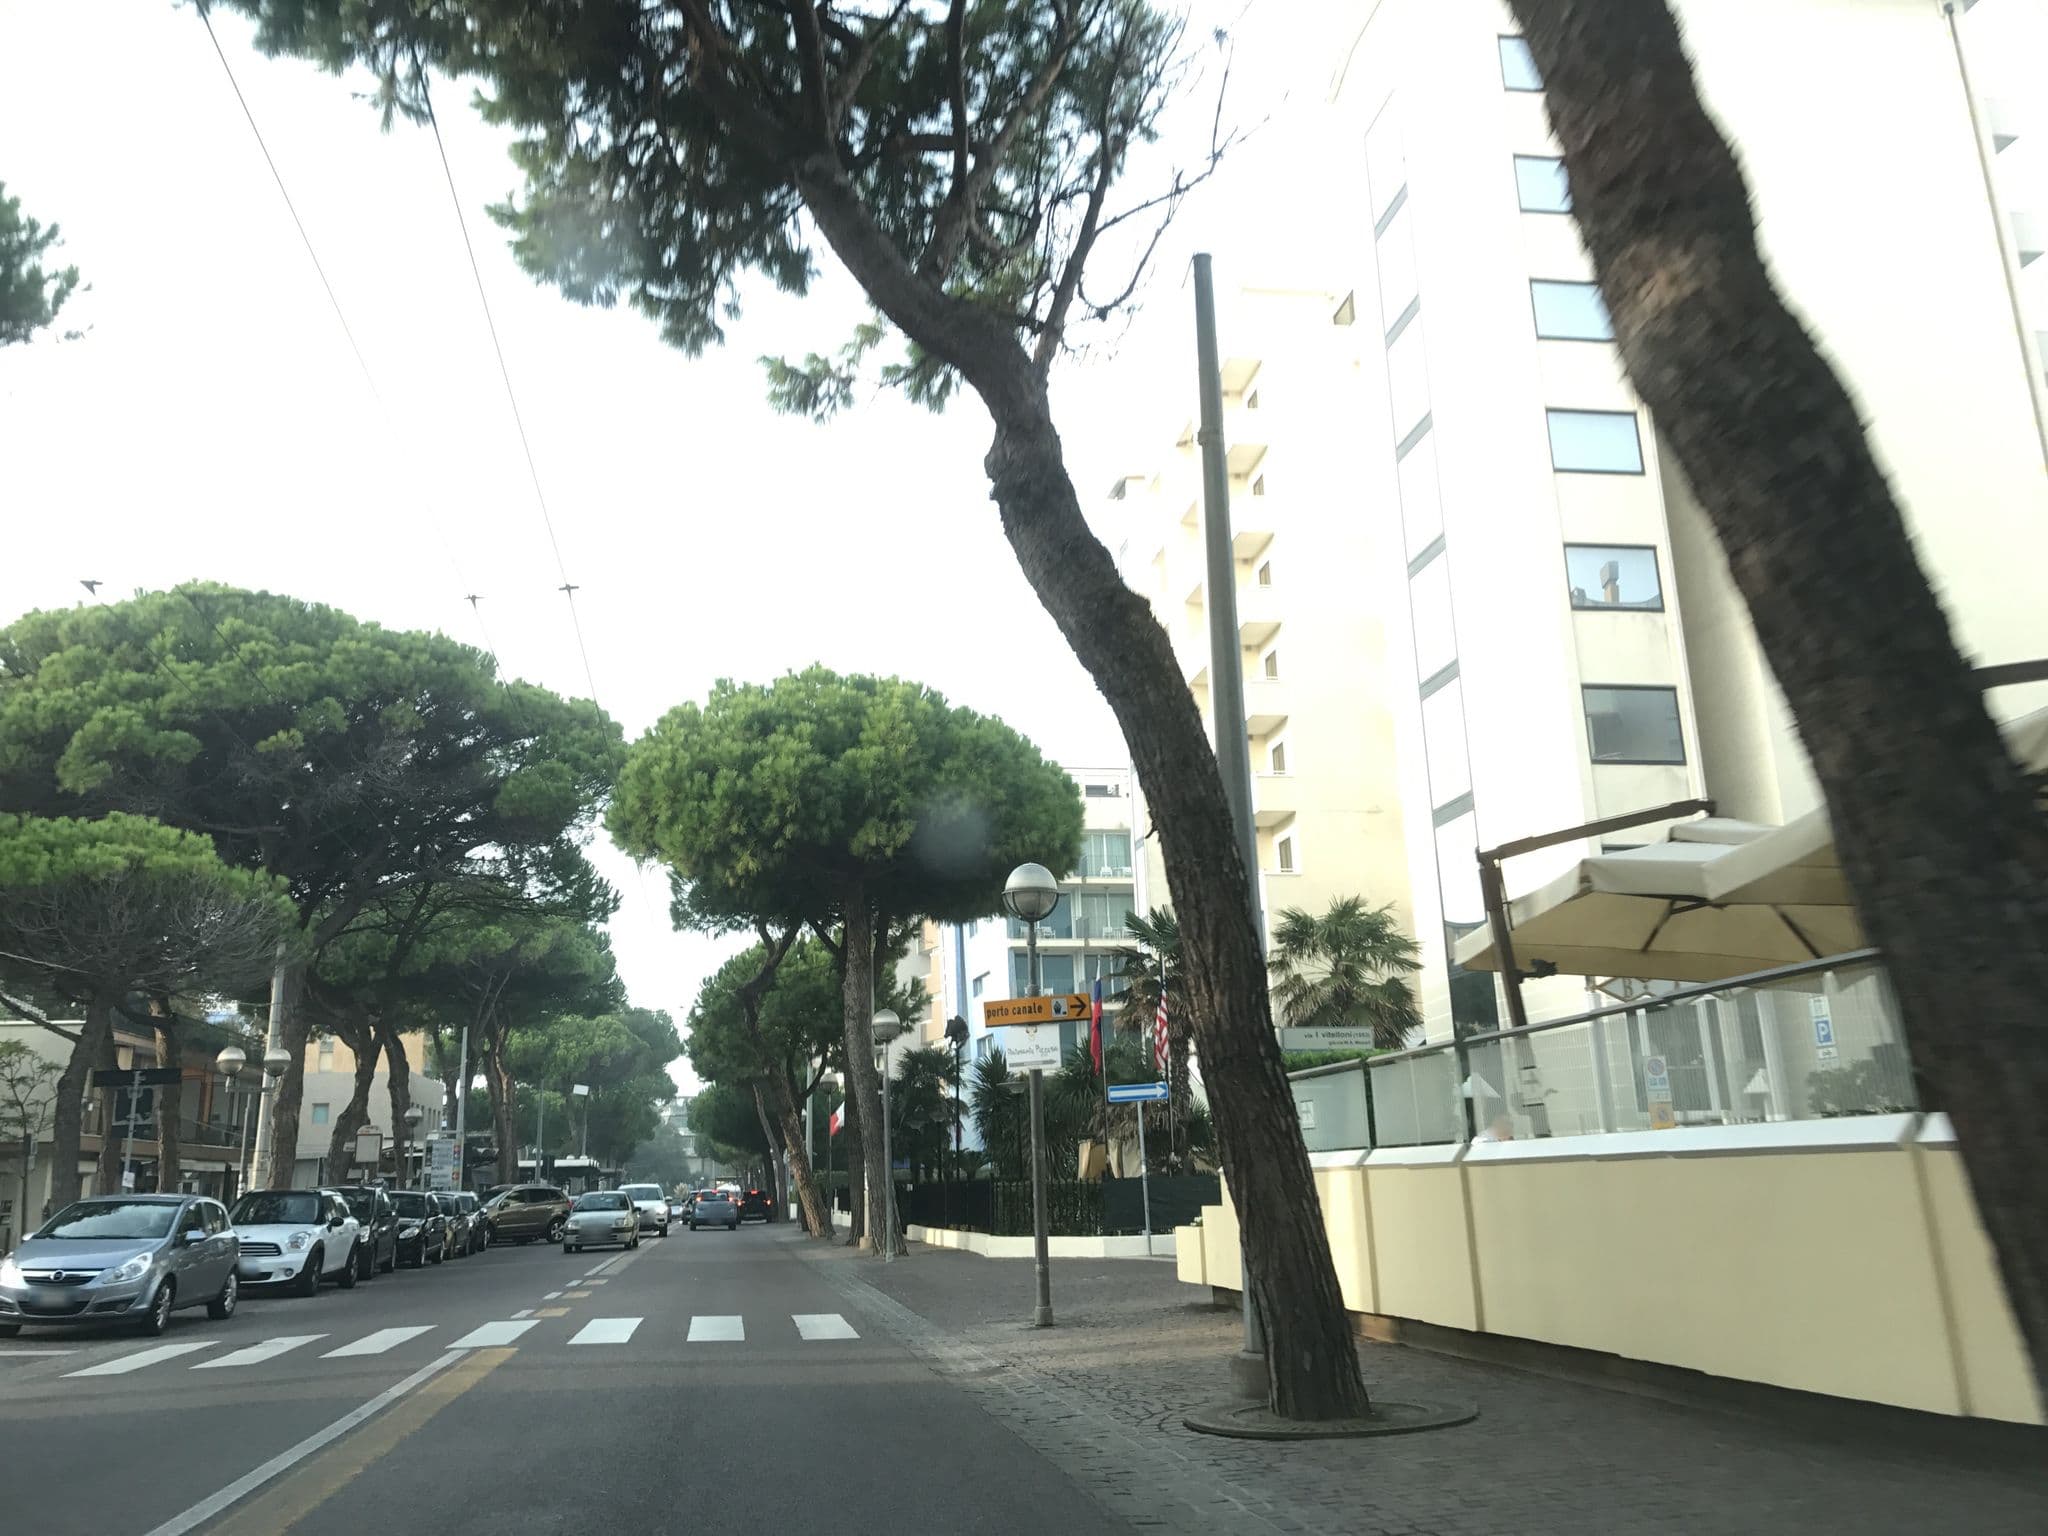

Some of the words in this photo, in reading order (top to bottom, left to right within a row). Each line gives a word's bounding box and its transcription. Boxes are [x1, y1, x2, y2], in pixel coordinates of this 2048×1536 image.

[986, 1006, 1009, 1020] porto
[1012, 1002, 1043, 1016] canale
[1817, 1022, 1829, 1042] P
